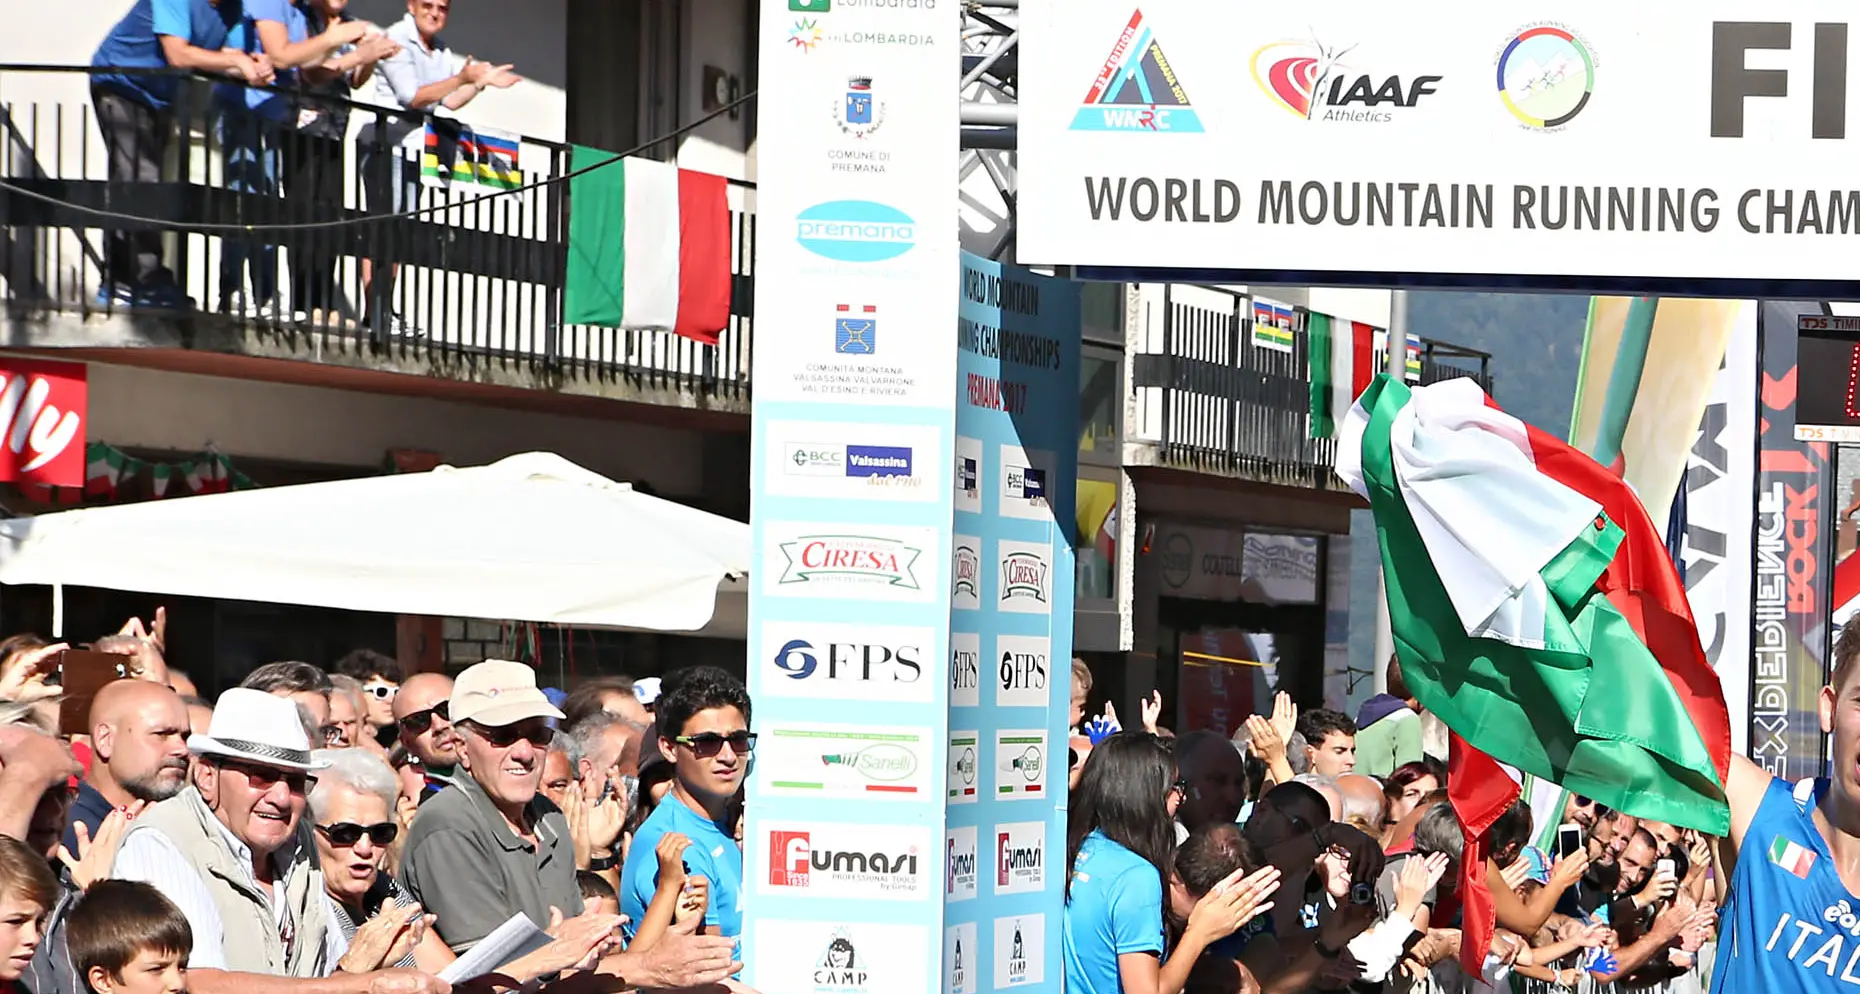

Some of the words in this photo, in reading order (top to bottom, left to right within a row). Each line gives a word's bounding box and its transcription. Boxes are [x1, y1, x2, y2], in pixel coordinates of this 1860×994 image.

[1326, 75, 1443, 107] IAAF
[1322, 108, 1392, 123] Athletics
[828, 150, 875, 160] COMUNE
[832, 163, 886, 173] PREMANA
[1085, 176, 1241, 223] WORLD
[1258, 180, 1493, 229] MOUNTAIN
[1513, 185, 1720, 234] RUNNING
[798, 222, 913, 240] premana
[987, 276, 1039, 317] MOUNTAIN
[1802, 317, 1828, 329] TDS
[981, 323, 1061, 372] CHAMPIONSHIPS
[793, 373, 853, 384] VALSASSINA
[857, 365, 903, 375] MONTANA
[0, 374, 80, 473] lly
[809, 451, 841, 463] BCC
[849, 453, 908, 468] Valsassina
[802, 541, 899, 573] CIRESA
[1008, 559, 1039, 588] CIRESA
[824, 642, 921, 684] FPS
[958, 650, 978, 689] FPS
[1014, 652, 1046, 690] FPS
[860, 755, 911, 772] Sanelli
[832, 873, 889, 883] PROFESSIONAL
[1008, 962, 1026, 976] CAMP
[813, 971, 868, 986] CAMP
